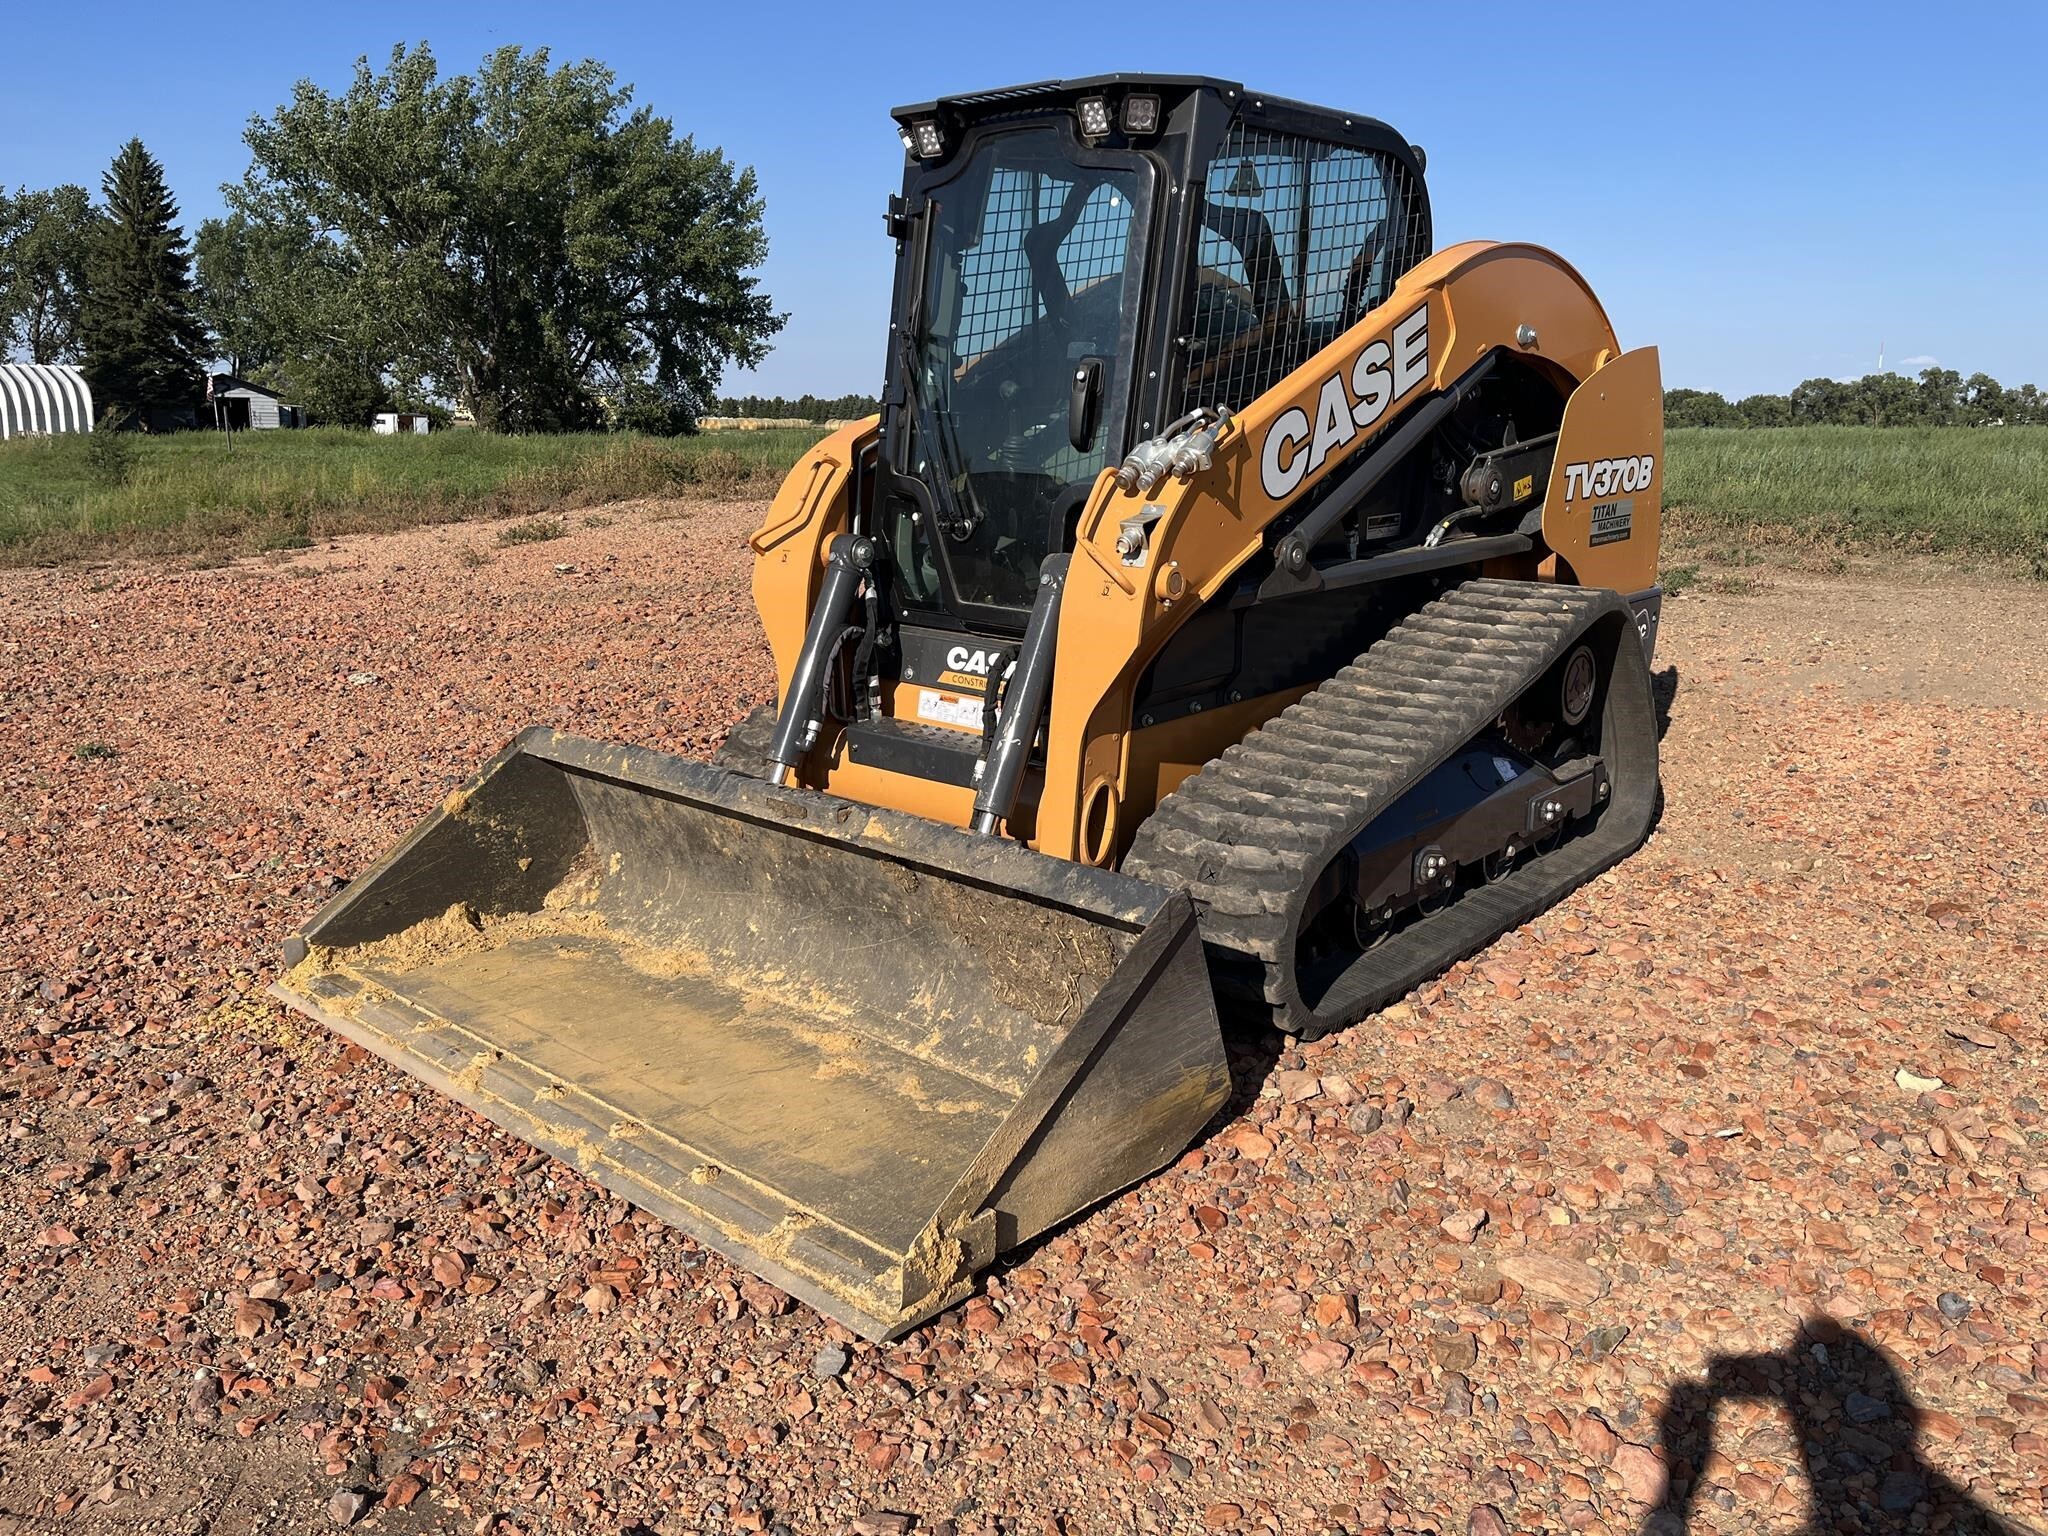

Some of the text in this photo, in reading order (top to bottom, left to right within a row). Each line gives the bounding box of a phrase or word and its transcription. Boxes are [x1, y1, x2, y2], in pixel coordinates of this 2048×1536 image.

[1261, 302, 1428, 500] CASE
[1565, 455, 1654, 502] TV370B
[1593, 502, 1618, 520] TITAN
[1597, 517, 1631, 531] MACHINERY
